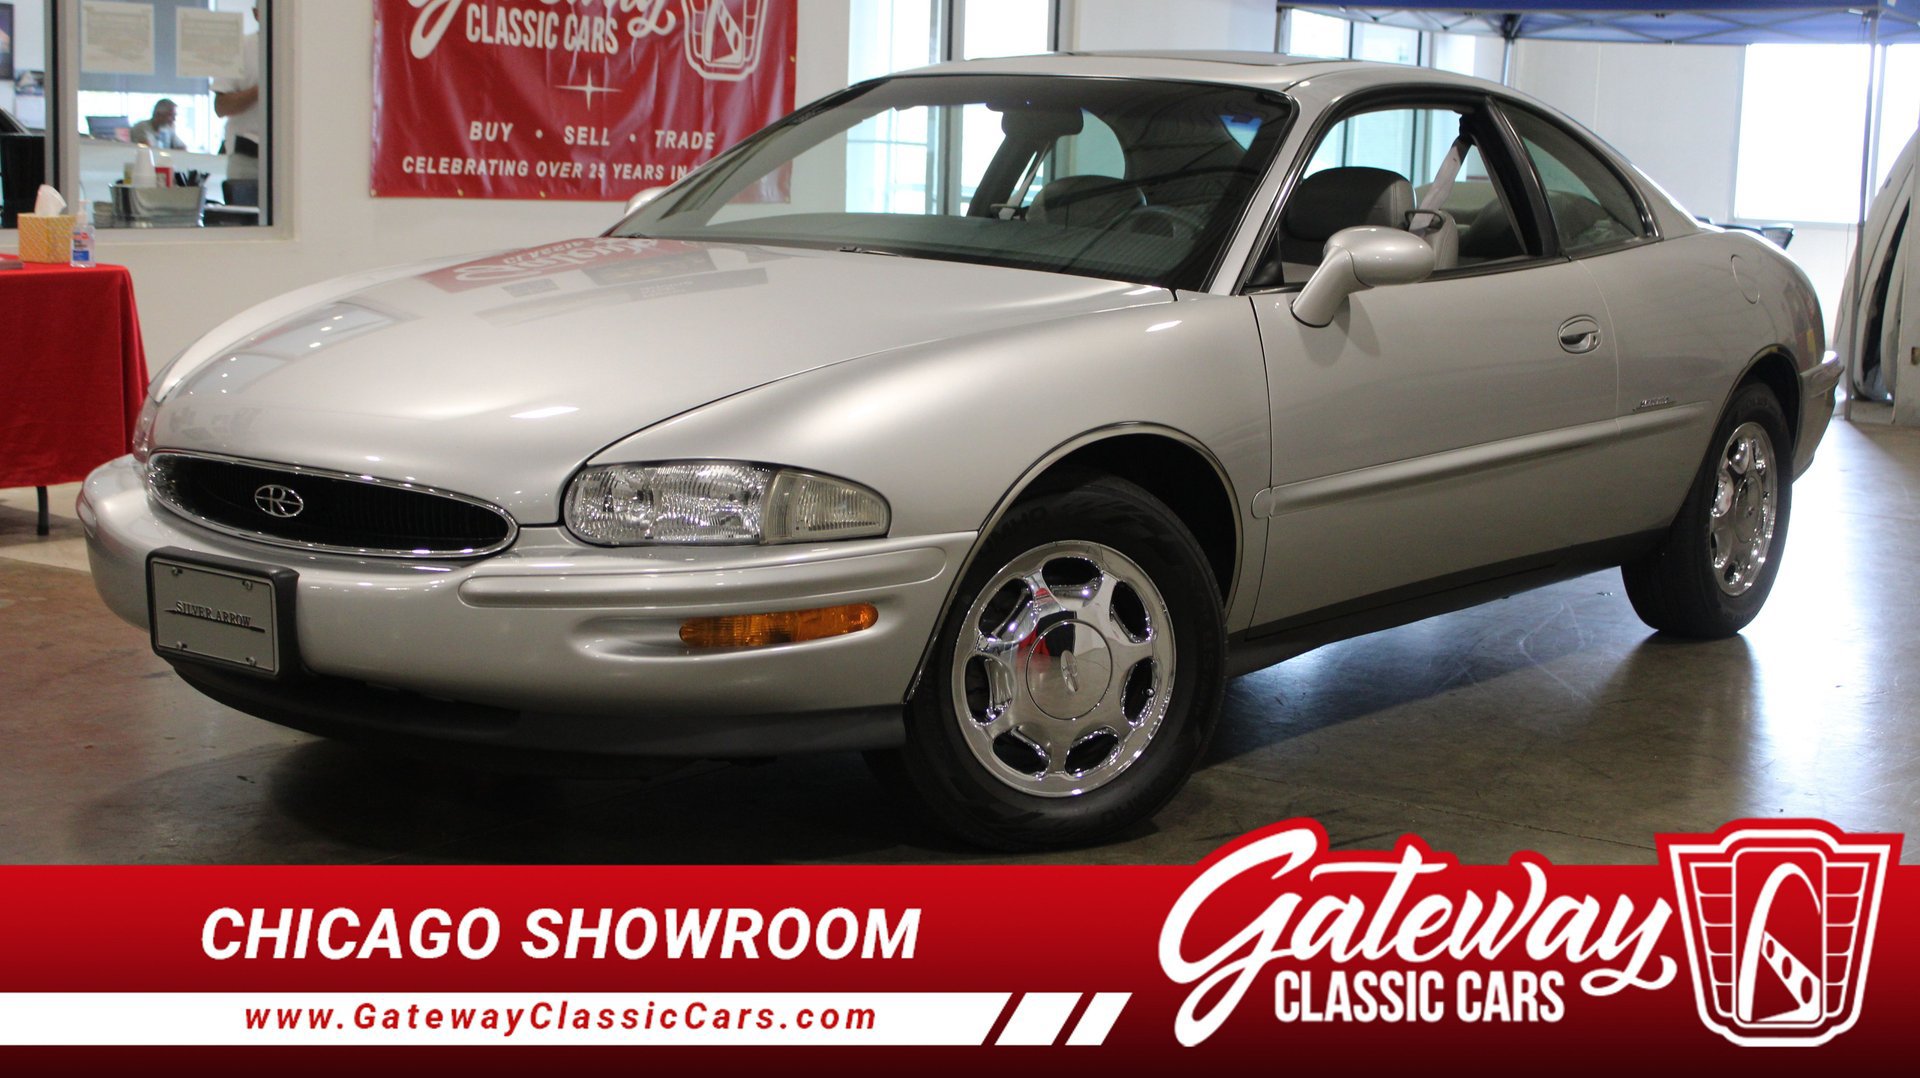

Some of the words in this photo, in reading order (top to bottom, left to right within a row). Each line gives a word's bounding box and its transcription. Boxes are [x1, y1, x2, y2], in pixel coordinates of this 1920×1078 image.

[466, 2, 559, 50] CLASSIC
[563, 13, 619, 55] CARS
[469, 121, 514, 142] BUY
[563, 125, 610, 146] SELL
[655, 130, 716, 150] TRADE
[402, 156, 529, 177] CELEBRATING
[535, 161, 583, 178] OVER
[588, 163, 606, 179] 25
[612, 163, 664, 180] YEARS
[671, 165, 687, 180] IN
[176, 600, 213, 620] SILVER
[216, 609, 251, 627] ARROW
